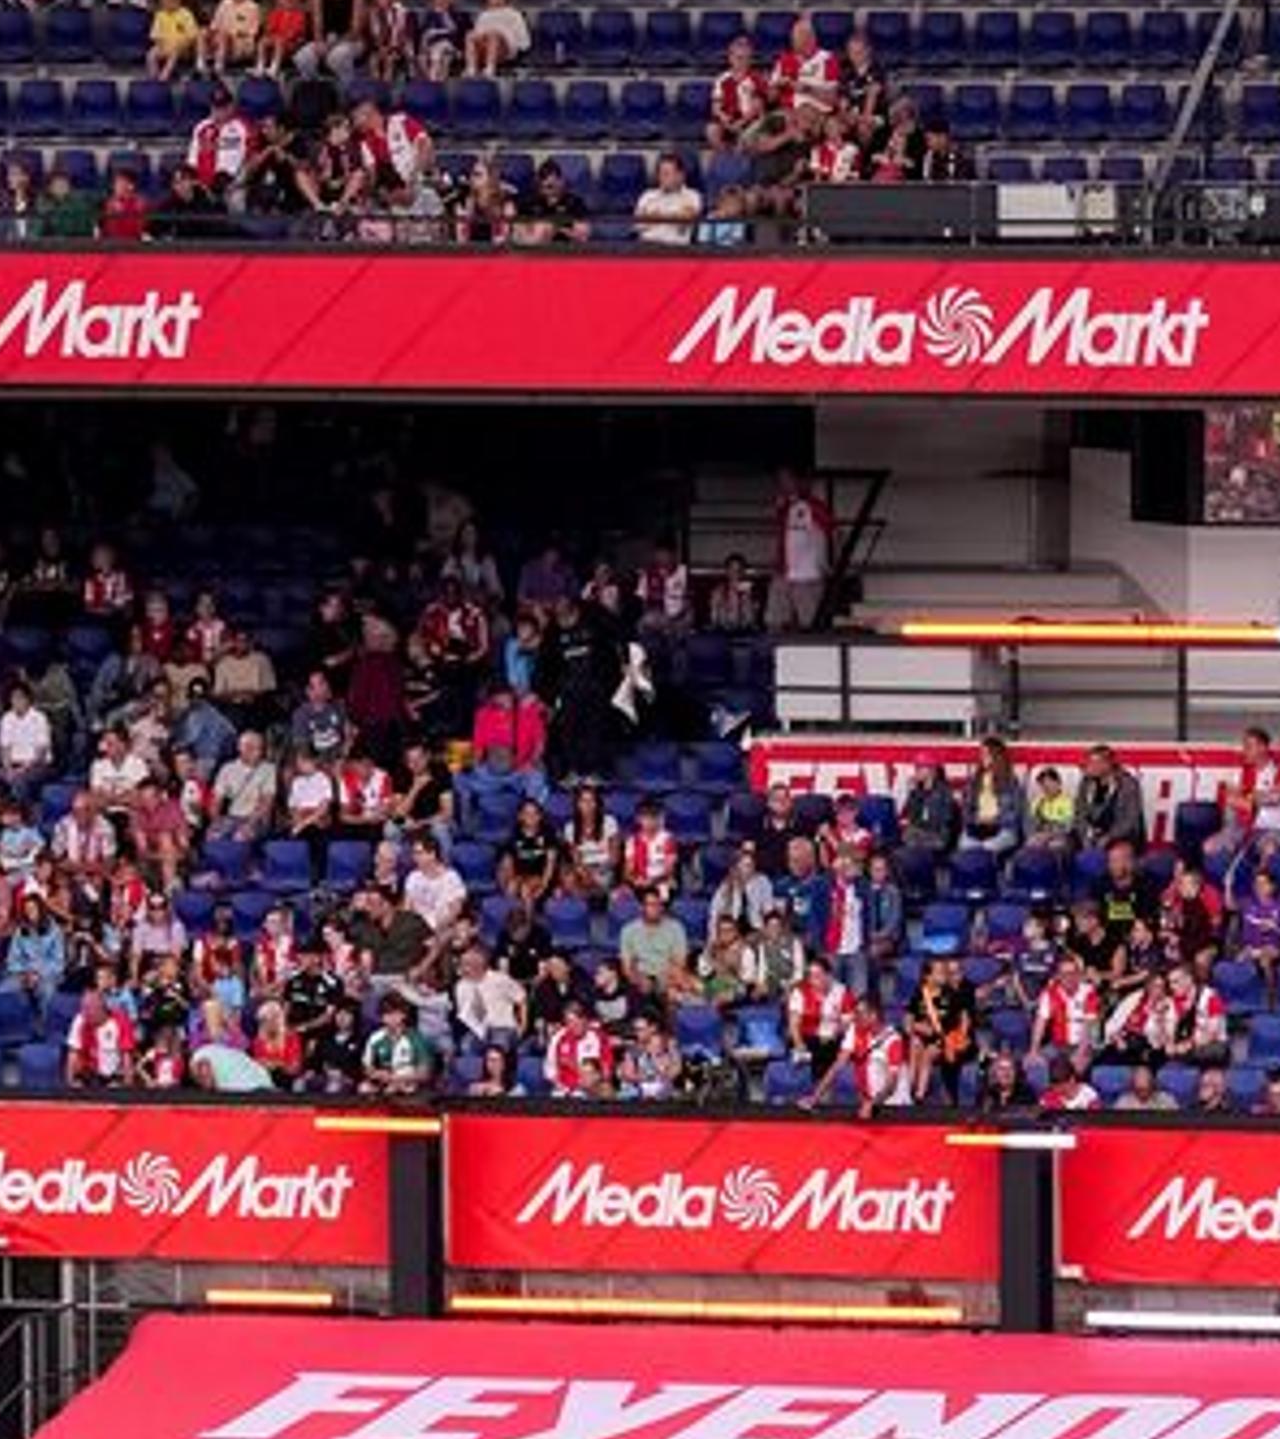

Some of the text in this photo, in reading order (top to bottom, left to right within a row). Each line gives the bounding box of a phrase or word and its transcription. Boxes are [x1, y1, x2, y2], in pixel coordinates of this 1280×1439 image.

[668, 286, 1209, 367] Media Markt
[173, 1155, 353, 1220] Markt
[517, 1159, 953, 1233] Media Markt
